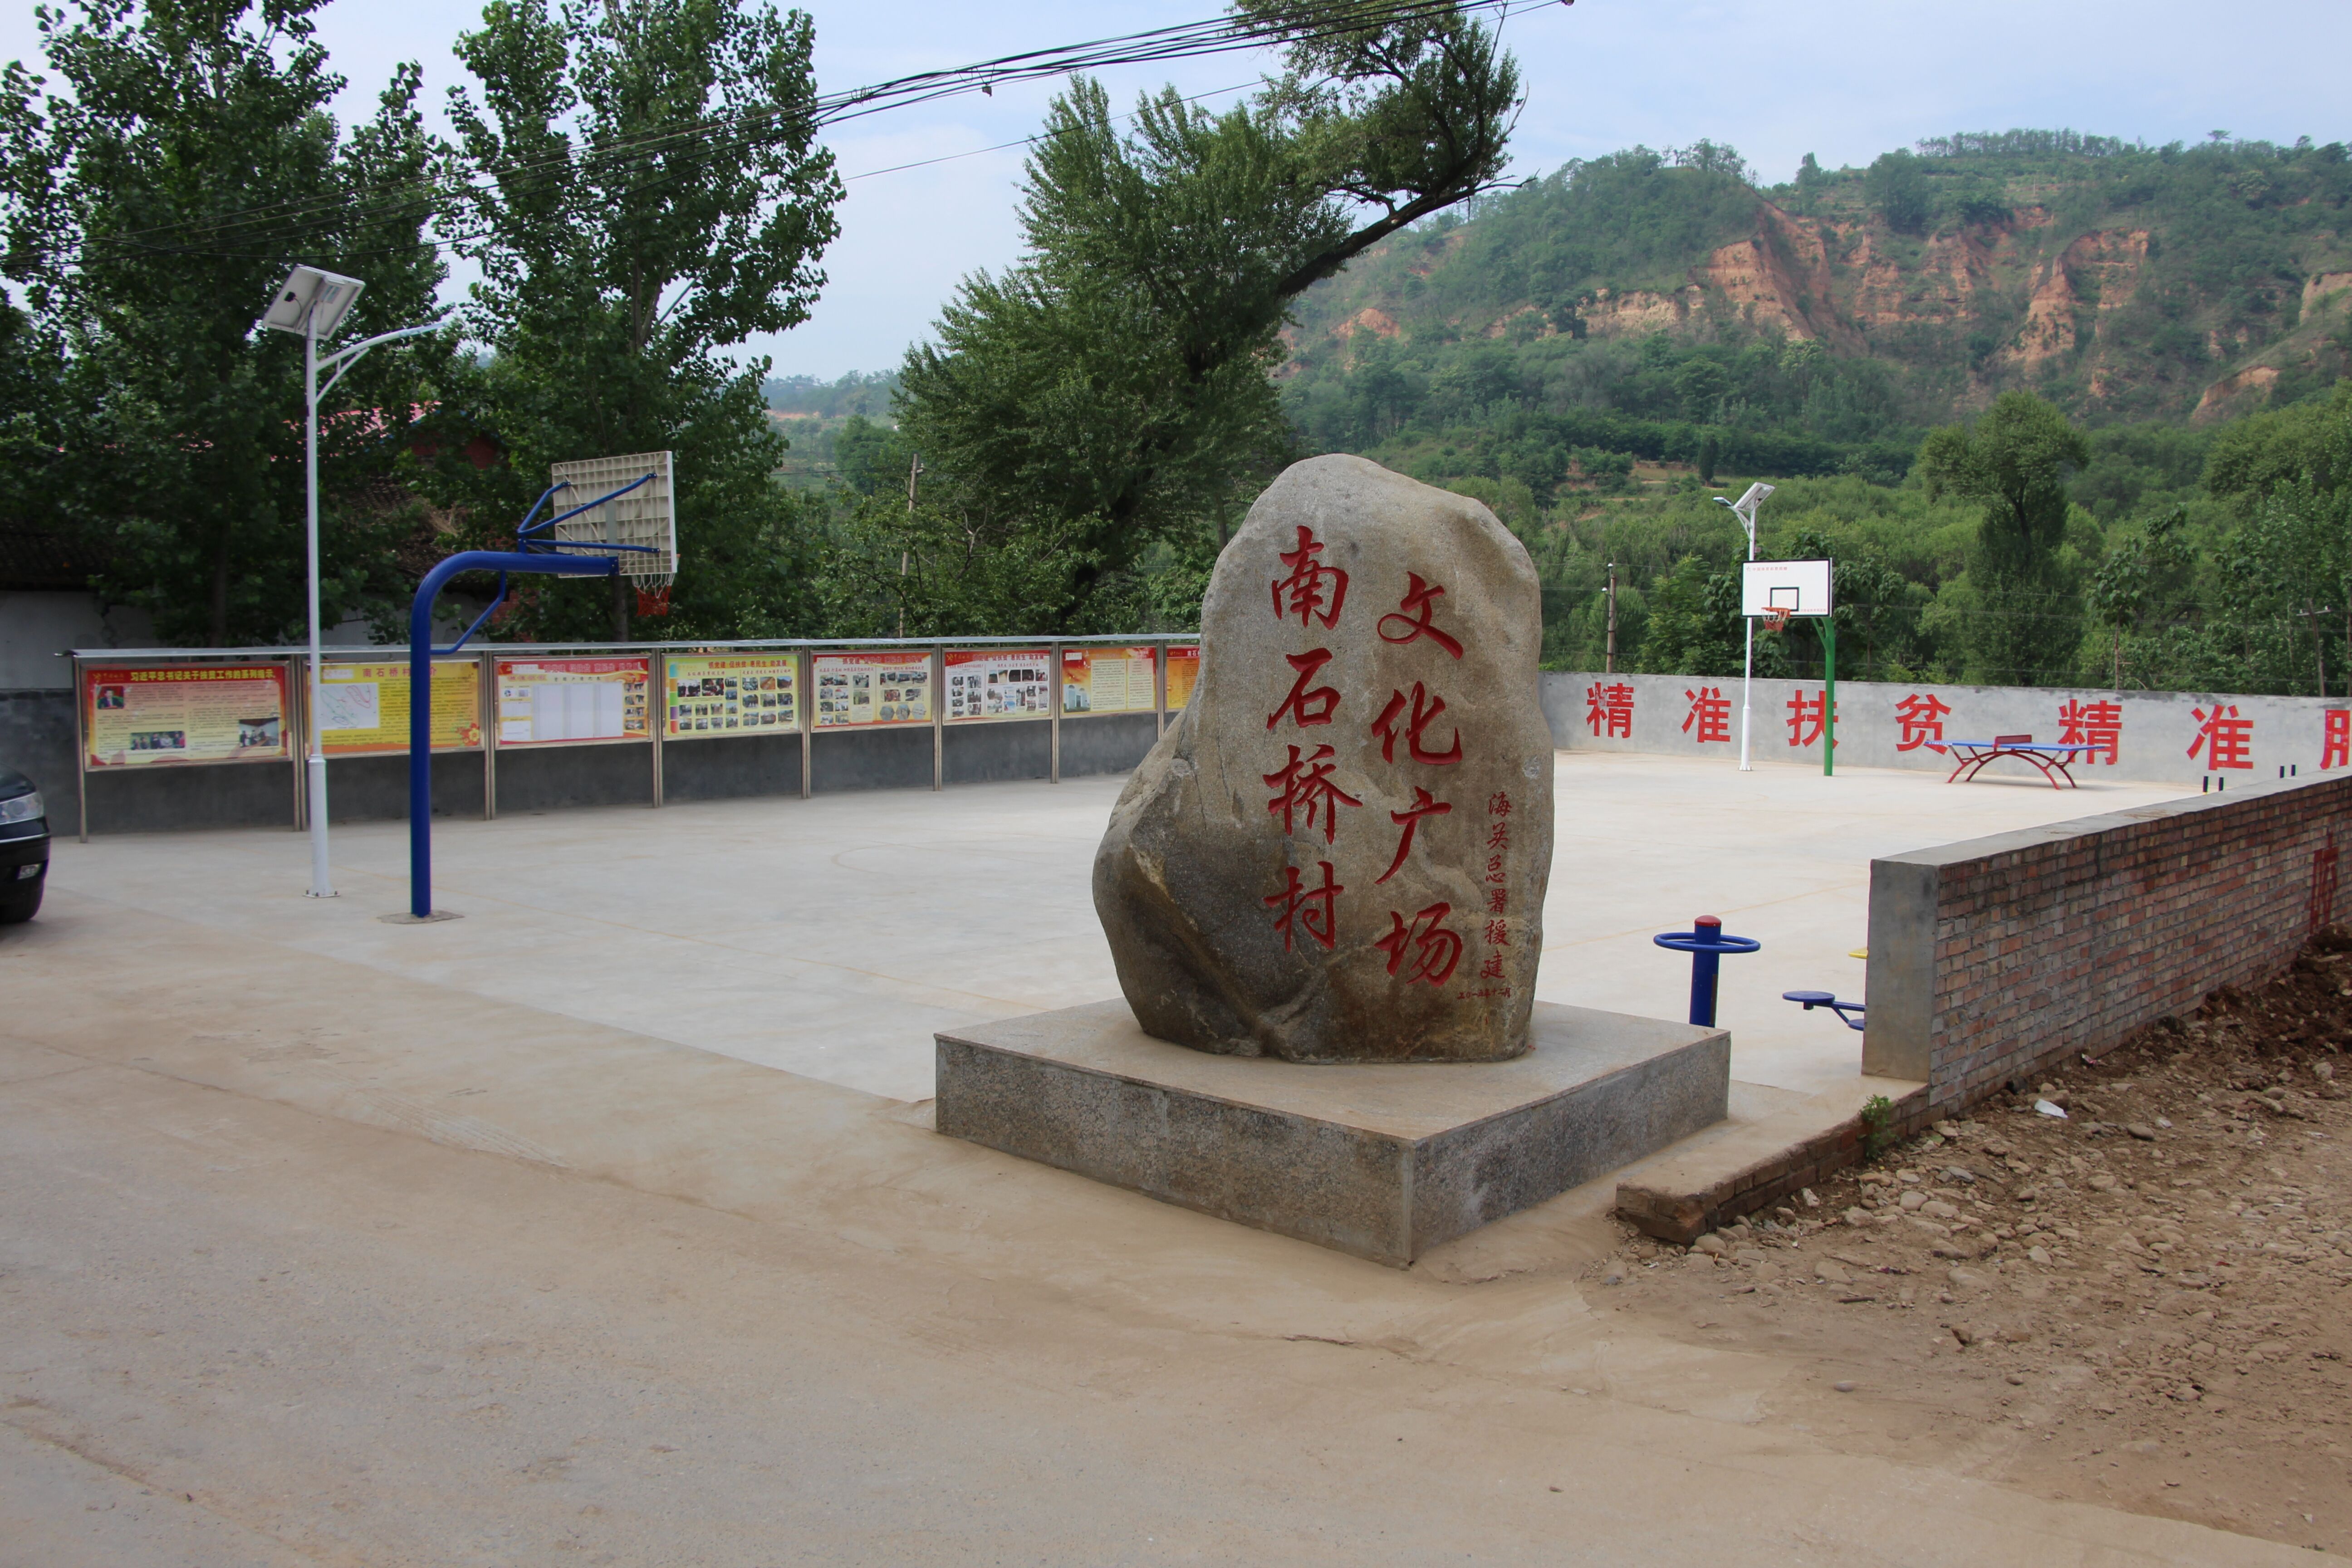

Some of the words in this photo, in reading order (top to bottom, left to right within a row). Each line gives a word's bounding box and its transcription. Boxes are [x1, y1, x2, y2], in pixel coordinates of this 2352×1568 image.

[363, 666, 437, 678] 南石桥村介
[1263, 525, 1362, 952] 南石桥村
[1586, 681, 1952, 755] 精准扶贫
[1371, 571, 1464, 988] 文化广场
[1480, 791, 1512, 980] 海关总署援建
